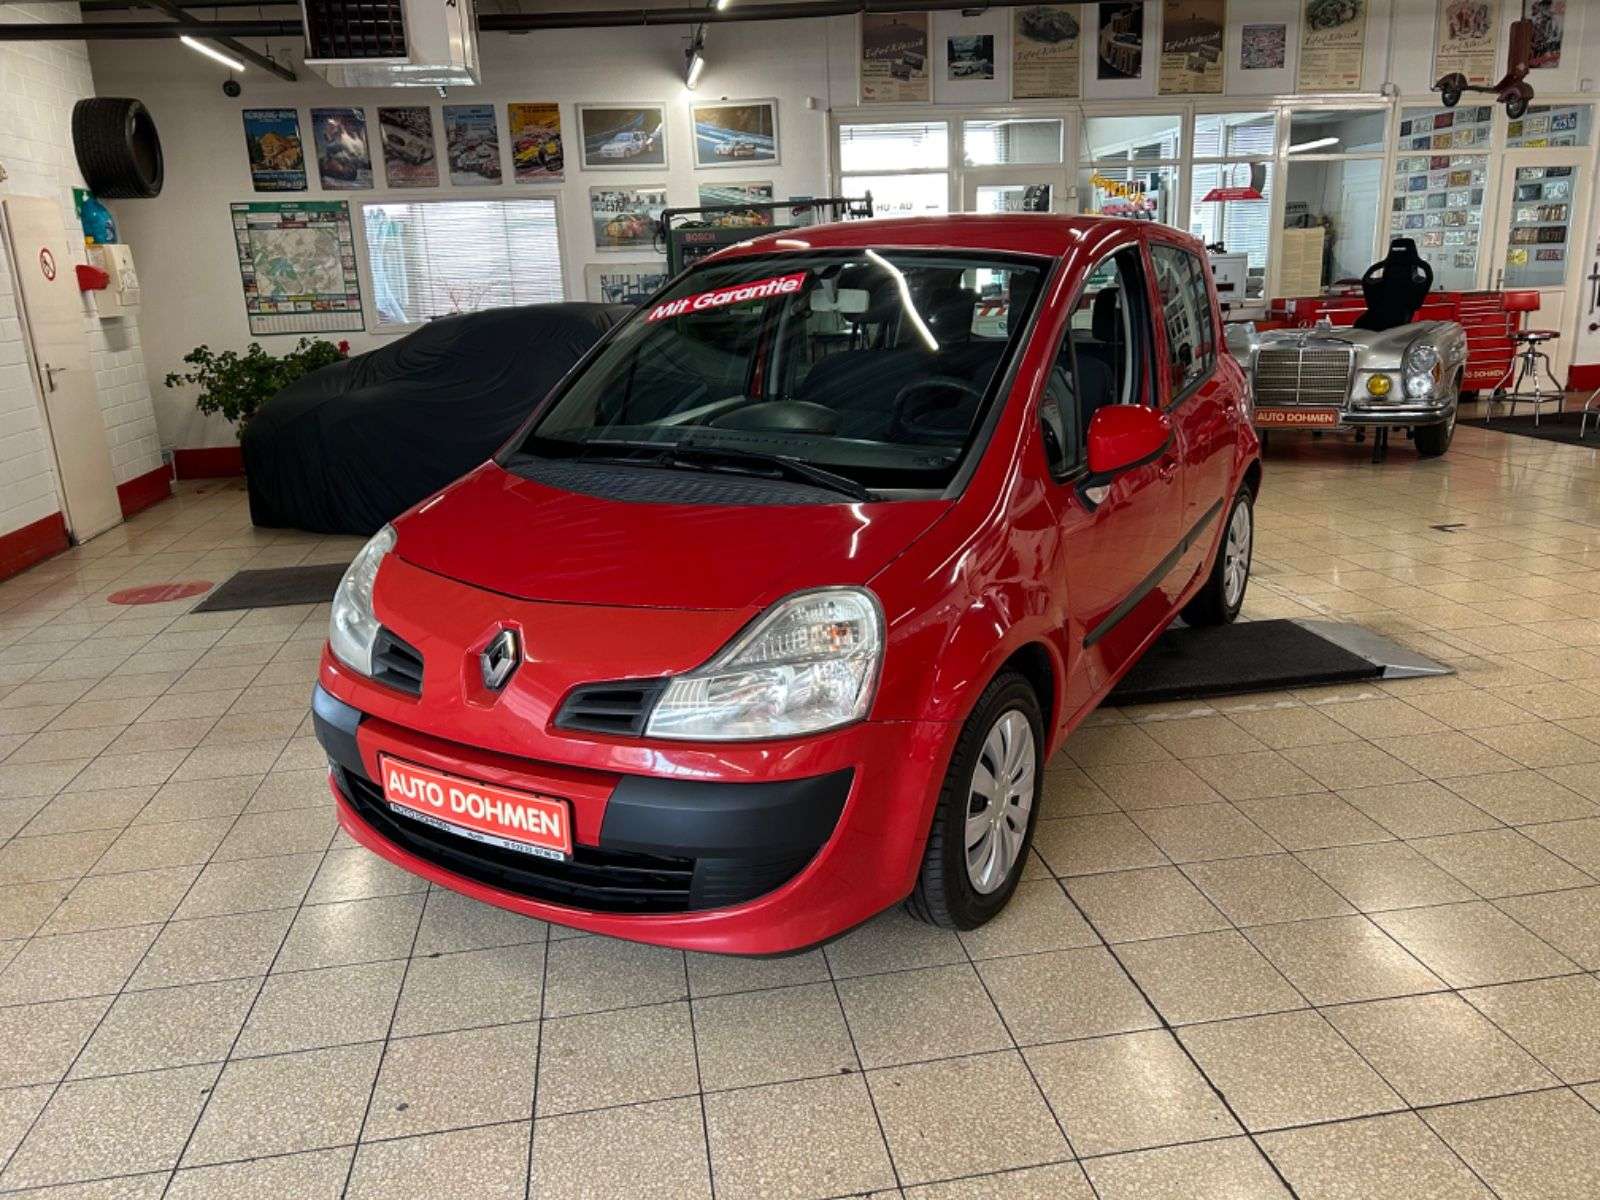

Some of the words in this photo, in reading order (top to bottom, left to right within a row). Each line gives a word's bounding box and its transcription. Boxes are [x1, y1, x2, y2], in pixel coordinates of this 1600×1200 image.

[685, 232, 716, 242] BOSCH
[649, 300, 690, 320] Mit
[693, 278, 799, 307] Garantie
[1257, 411, 1285, 423] AUTO
[1286, 411, 1333, 424] DOHMEN
[389, 769, 444, 807] AUTO
[449, 788, 561, 837] DOHMEN
